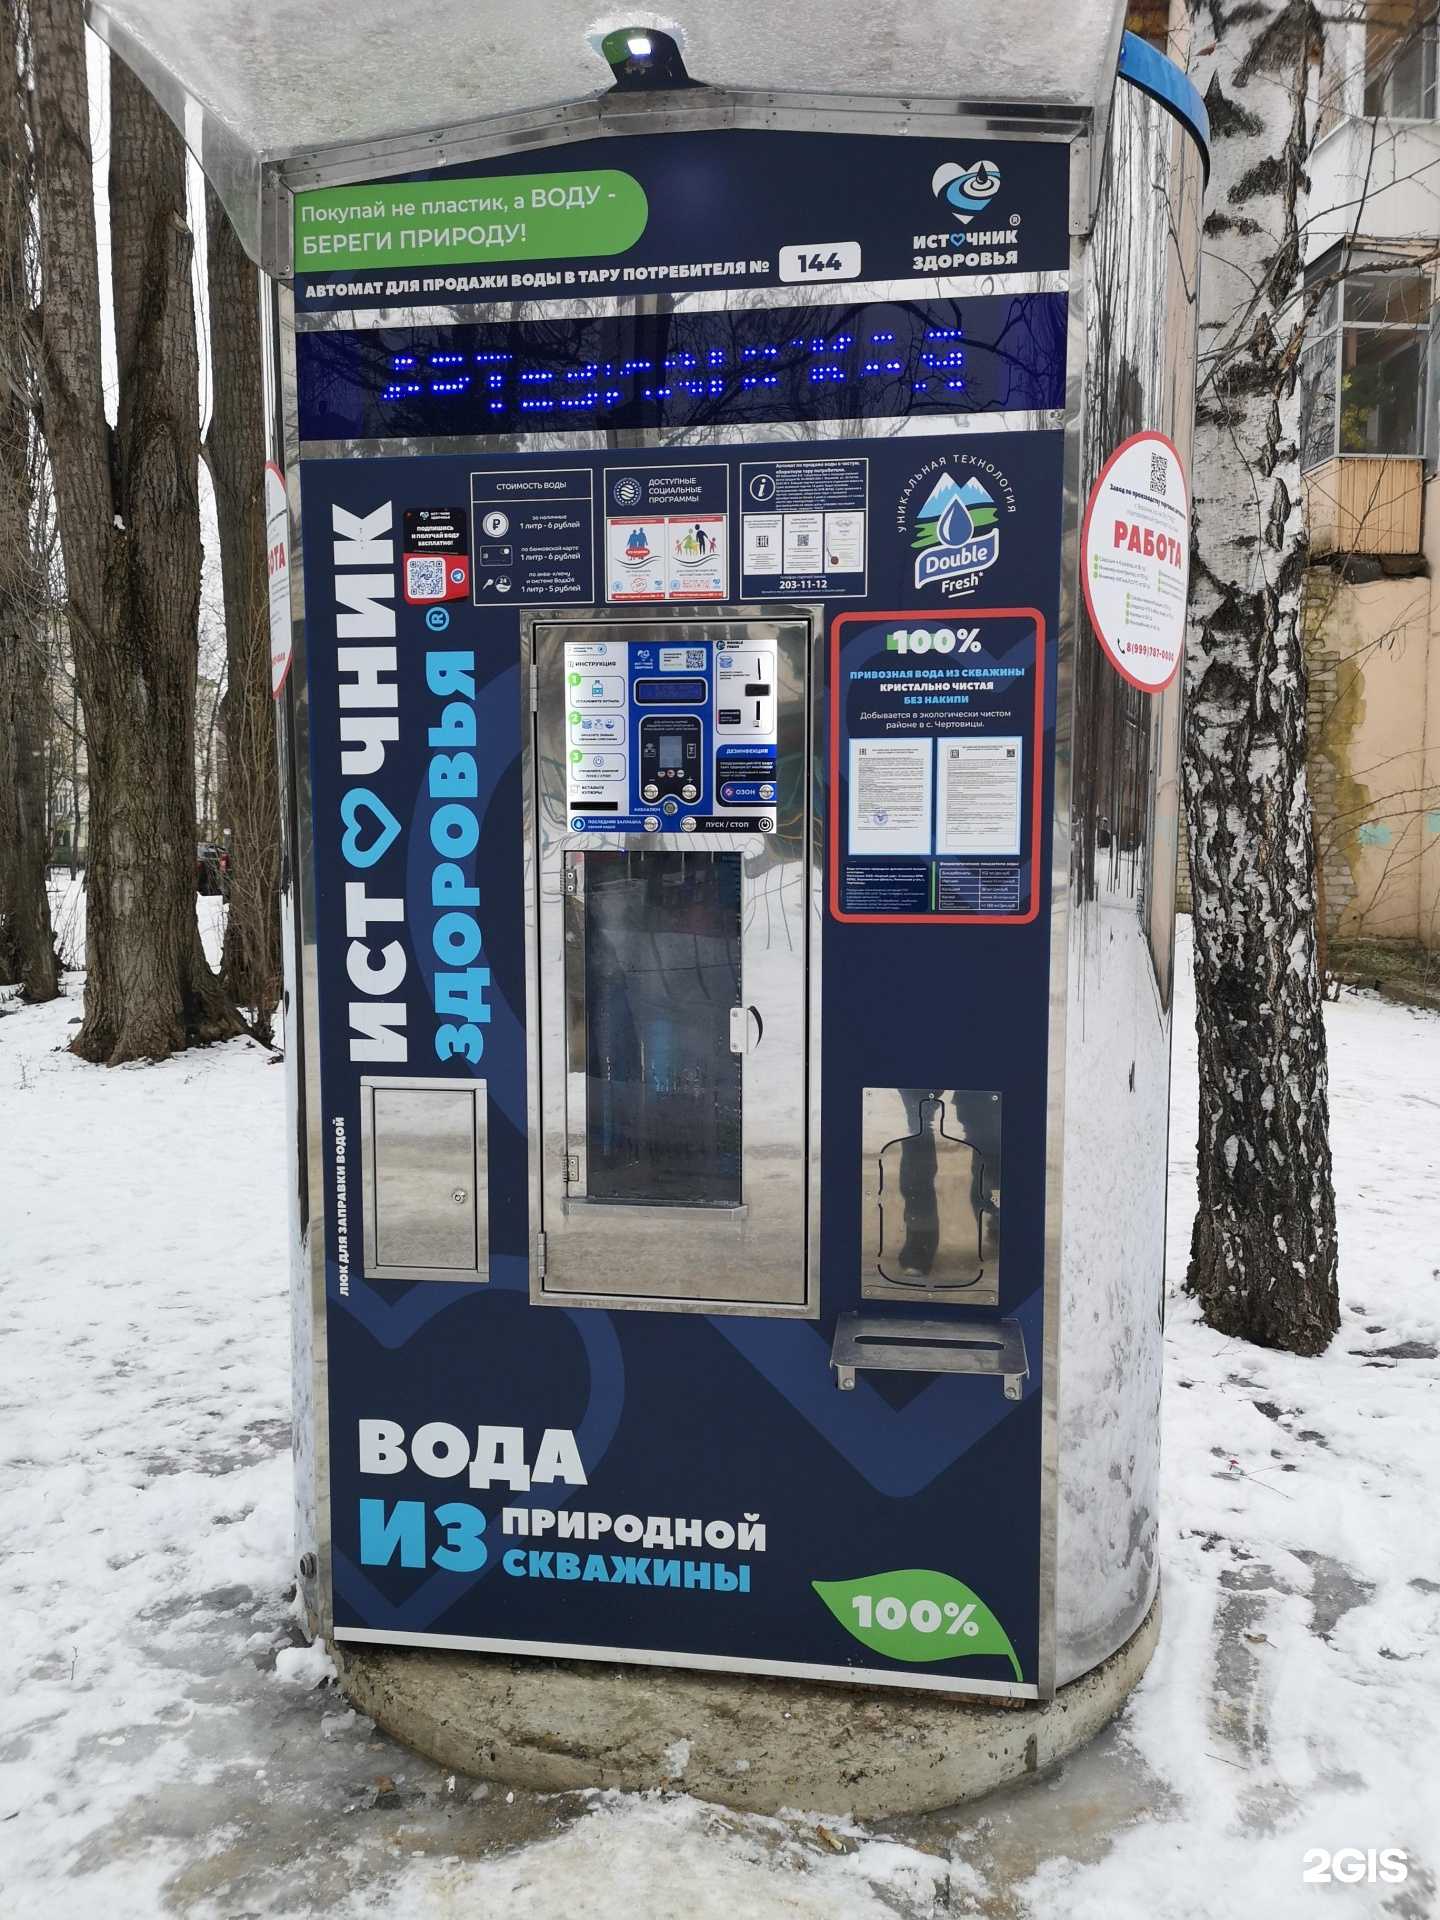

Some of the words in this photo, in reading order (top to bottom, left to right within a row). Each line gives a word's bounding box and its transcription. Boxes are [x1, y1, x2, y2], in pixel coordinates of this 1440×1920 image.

[302, 200, 386, 225] Покупай
[392, 203, 416, 218] не
[422, 195, 508, 216] пластик,
[514, 196, 525, 210] а
[531, 185, 602, 210] ВОДУ
[303, 230, 392, 255] БЕРЕГИ
[400, 223, 527, 249] ПРИРОДУ!
[306, 281, 384, 298] АВТОМАТ
[385, 280, 420, 296] ДЛЯ
[423, 275, 509, 294] ПРОДАЖИ
[512, 273, 562, 289] ВОДЫ
[565, 272, 576, 285] В
[578, 269, 621, 284] ТАРУ
[624, 261, 746, 281] ПОТРЕБИТЕЛЯ
[797, 252, 842, 273] 144
[913, 250, 1018, 272] ЗДОРОВЬЯ
[496, 482, 542, 491] СТОИМОСТЬ
[544, 481, 567, 490] ВОДЫ
[648, 477, 697, 487] ДОСТУПНЫЕ
[648, 486, 702, 495] СОЦИАЛЬНЫЕ
[897, 457, 947, 533] УНИКАЛЬНАЯ
[953, 454, 1017, 513] ТЕХНОЛОГИЯ
[648, 496, 699, 504] ПРОГРАММЫ
[553, 520, 580, 530] рублей
[554, 552, 581, 562] рублей
[1113, 520, 1181, 569] РАБОТА
[268, 542, 286, 576] ОТА
[925, 545, 988, 573] Double
[554, 584, 581, 594] рублей
[780, 580, 828, 589] 203-11-12
[892, 628, 982, 654] 100%
[850, 669, 913, 680] ПРИВОЗНАЯ
[915, 669, 943, 679] ВОДА
[945, 668, 960, 678] ИЗ
[961, 667, 1025, 677] СКВАЖИНЫ
[879, 682, 951, 692] КРИСТАЛЬНО
[952, 681, 994, 690] ЧИСТАЯ
[904, 696, 923, 705] БЕЗ
[925, 695, 969, 704] НАКИПИ
[860, 710, 911, 720] Добывается
[919, 710, 979, 721] экологически
[980, 710, 1011, 718] чистом
[886, 720, 918, 730] районе
[934, 720, 985, 731] Чертовицы.
[426, 650, 491, 1065] ЗДОРОВЬЯ
[332, 1116, 346, 1164] ВОДОЙ
[336, 1165, 347, 1234] ЗАПРАВКИ
[338, 1236, 350, 1264] ДЛЯ
[339, 1264, 349, 1296] ЛЮК
[358, 1418, 588, 1492] ВОДА
[358, 1498, 488, 1573] ИЗ
[502, 1507, 767, 1552] ПРИРОДНОЙ
[502, 1549, 750, 1593] СКВАЖИНЫ
[852, 1595, 980, 1638] 100%
